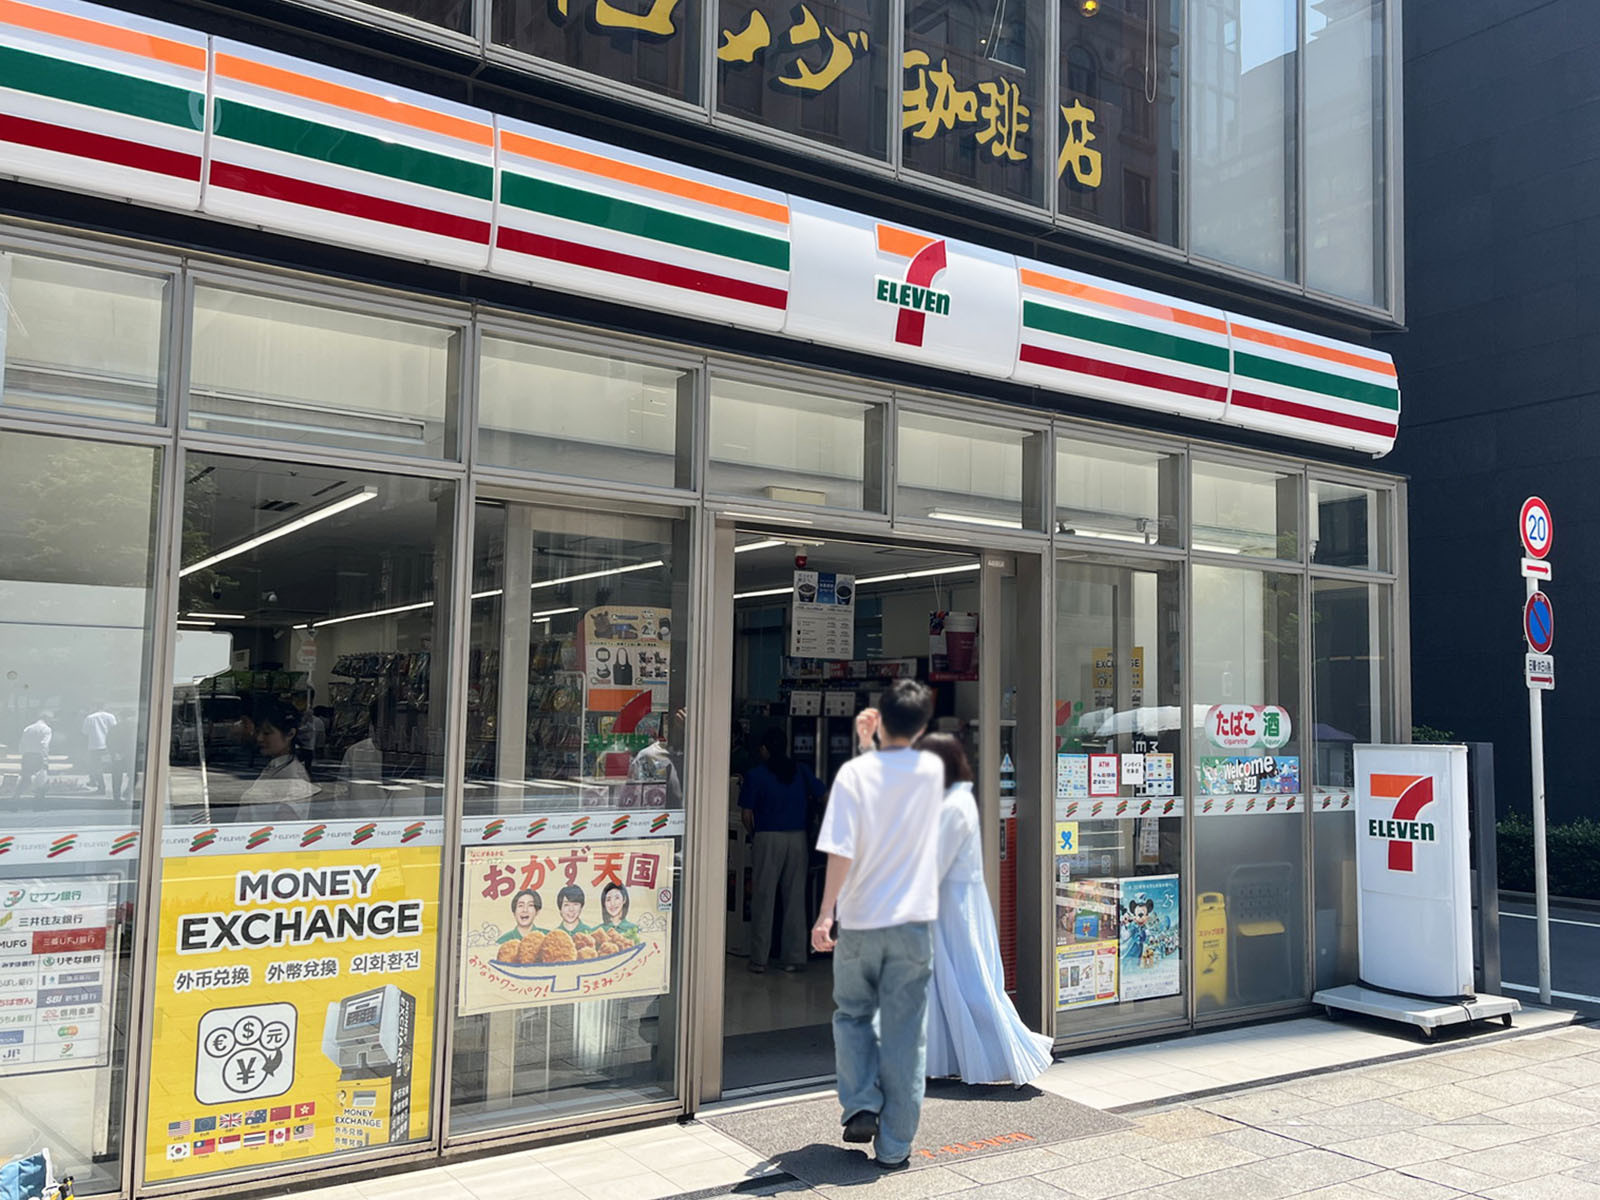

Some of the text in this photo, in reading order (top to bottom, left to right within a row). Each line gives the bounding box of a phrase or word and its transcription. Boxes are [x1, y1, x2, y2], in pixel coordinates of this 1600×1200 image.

[1528, 514, 1547, 543] 20
[1216, 710, 1280, 737] たばこ 酒
[1223, 756, 1275, 780] Welcome
[239, 868, 377, 901] MONEY
[481, 845, 660, 900] おかず天国
[18, 914, 83, 927] 三井住友銀行
[181, 903, 420, 951] EXCHANGE
[56, 954, 101, 966] りそな銀行
[350, 950, 420, 974] 외화환전
[176, 967, 250, 991] 外币兑换
[266, 1028, 283, 1044] 元
[236, 1056, 257, 1085] ¥
[335, 1116, 382, 1128] EXCHANGE
[343, 1108, 374, 1118] MONEY
